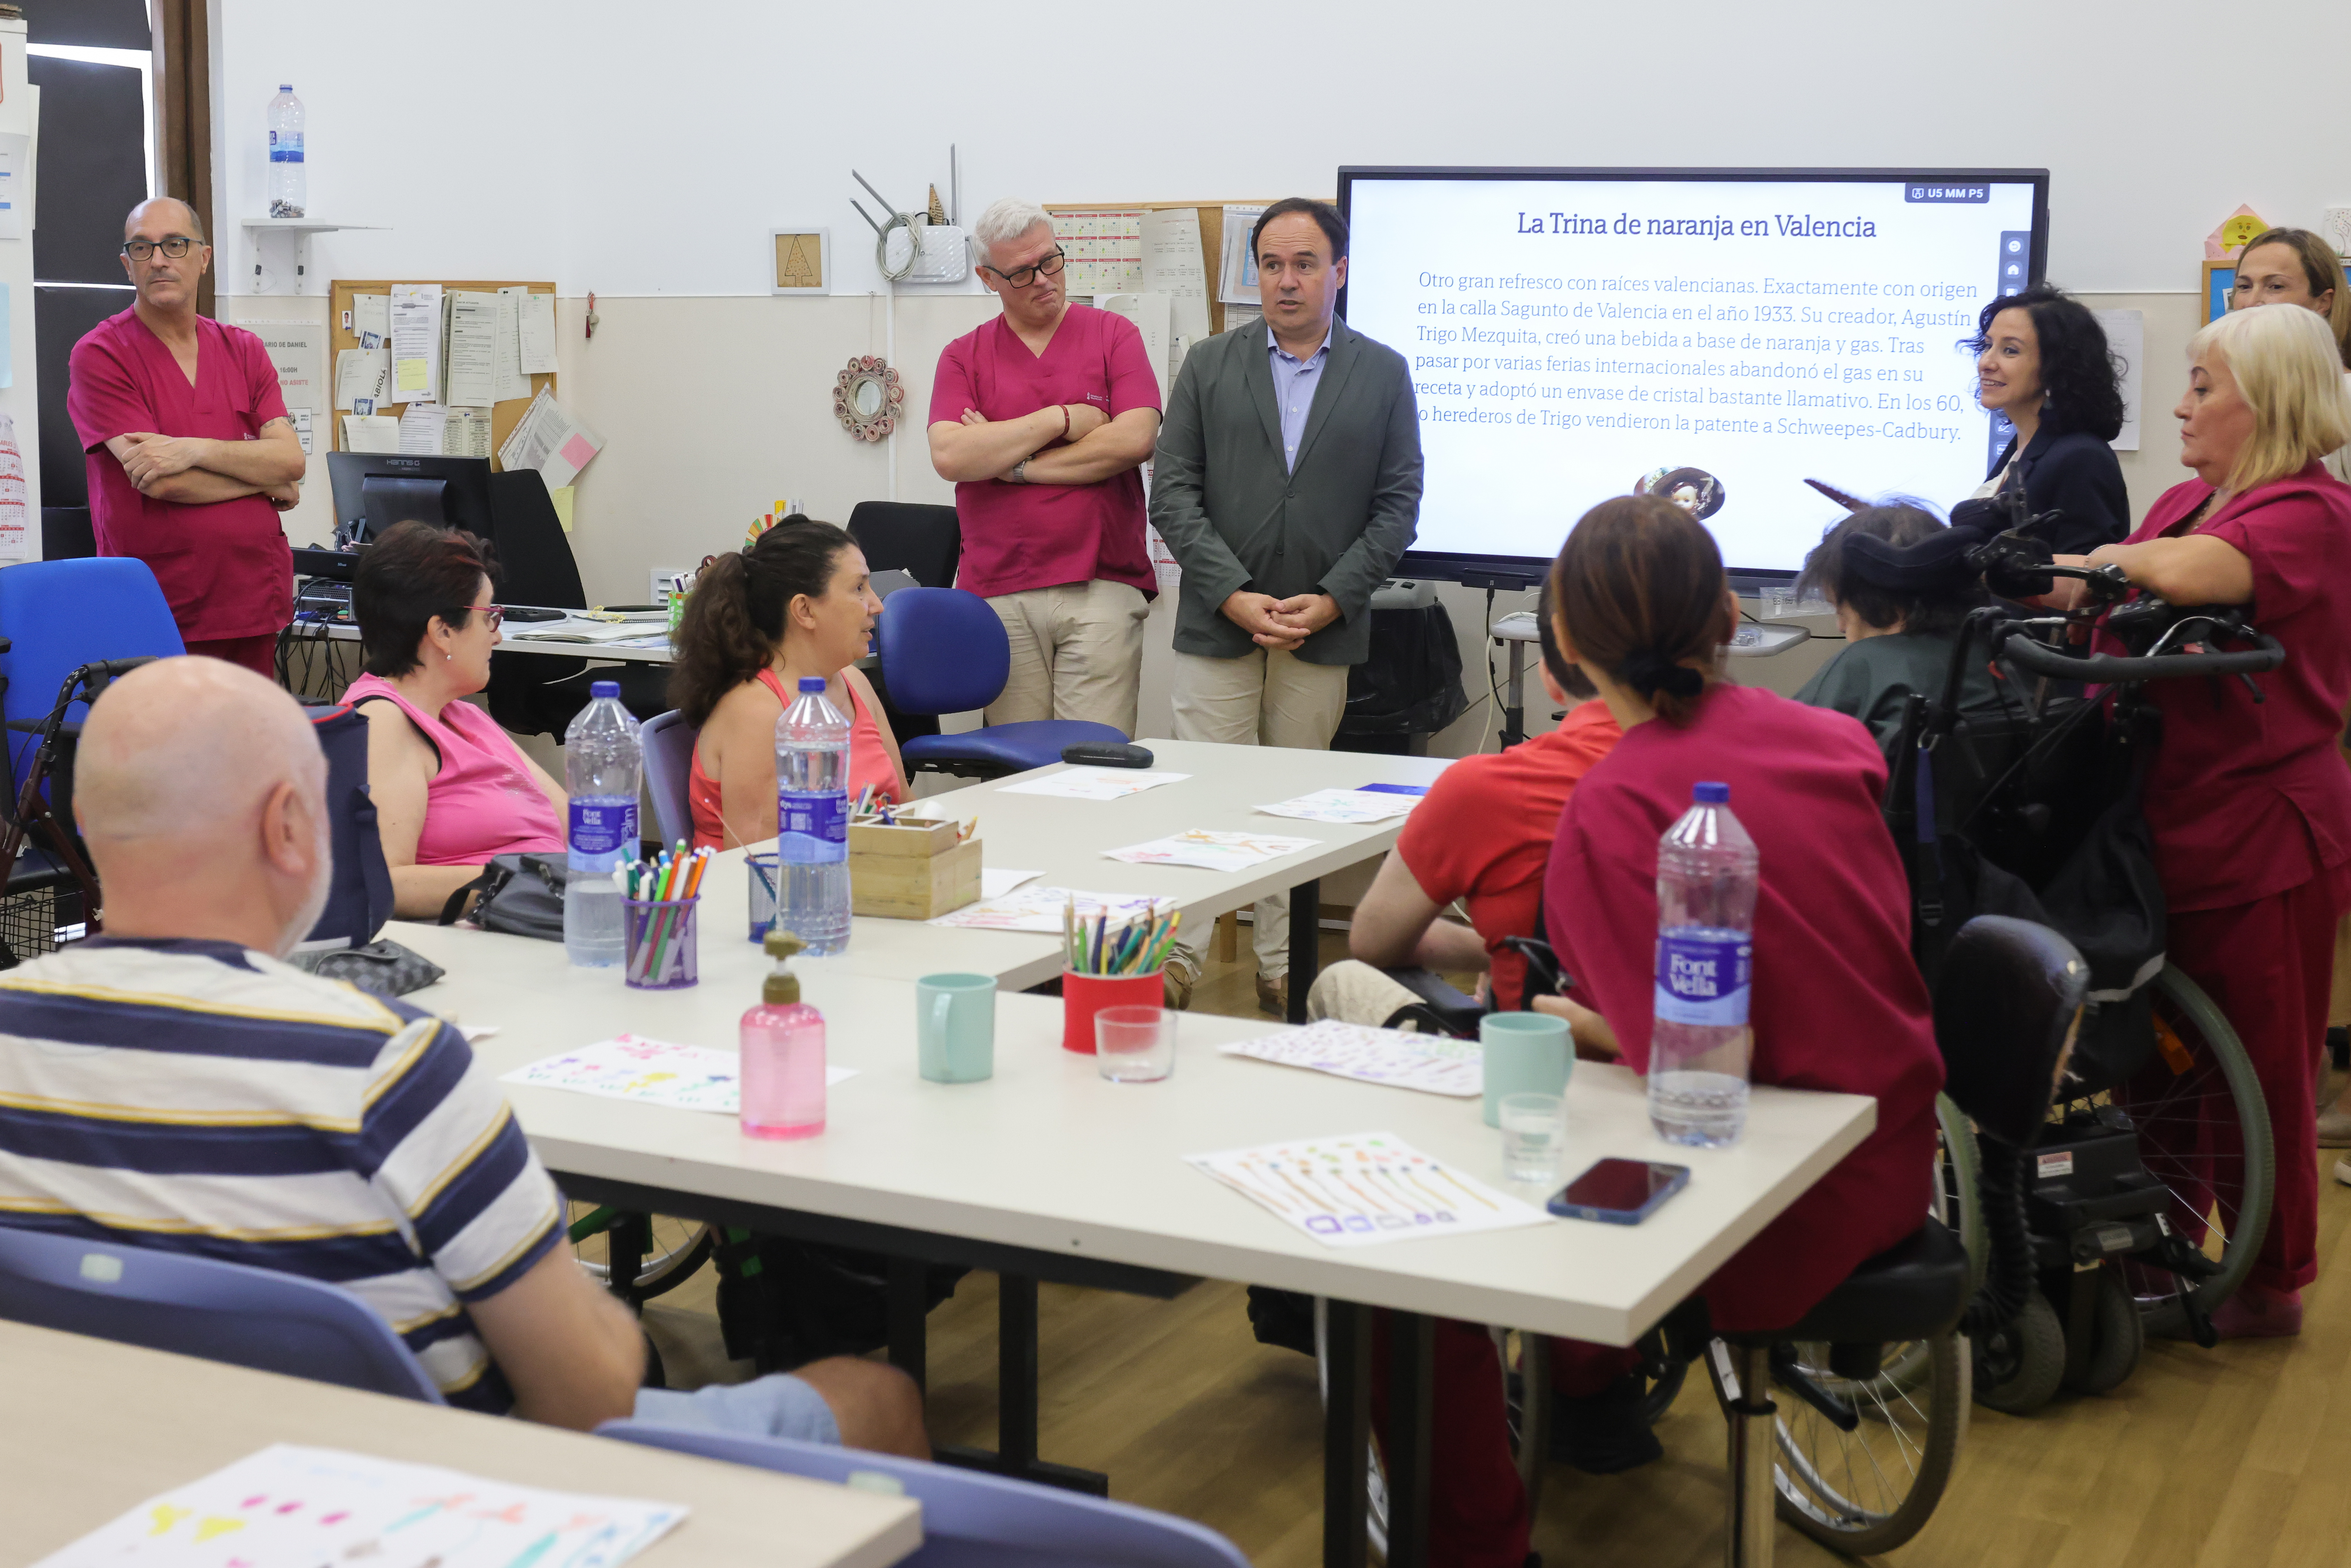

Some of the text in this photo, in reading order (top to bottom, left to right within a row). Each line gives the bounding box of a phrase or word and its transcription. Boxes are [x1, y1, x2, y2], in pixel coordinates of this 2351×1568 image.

[1928, 188, 1983, 198] U5 MM P5
[1518, 212, 1877, 240] La Trina de naranja en Valencia
[1420, 272, 1977, 300] Otro gran refresco con raíces valencianas. Exactamente con origen
[1419, 299, 1970, 328] en la calla Sagunto de Valencia en el año 1933. Su creador, Agustín
[1417, 326, 1924, 355] Trigo Mezquita, creó una bebida a base de naranja y gas. Tras
[1415, 356, 1923, 383] pasar por varias ferias internacionales abandonó el gas en su
[1415, 381, 1963, 414] receta y adoptó un envase de cristal bastante llamativo. En los 60,
[1433, 406, 1511, 423] herederos
[1517, 409, 1535, 424] de
[1541, 411, 1581, 429] Trigo
[1586, 413, 1670, 429] vendieron
[1676, 414, 1689, 429] la
[1694, 418, 1758, 434] patente
[1764, 422, 1772, 432] a
[1778, 419, 1960, 443] Schweepes-Cadbury.
[582, 816, 602, 825] Vella
[583, 809, 601, 818] Font
[1671, 953, 1716, 977] Font
[1670, 973, 1717, 997] Vella
